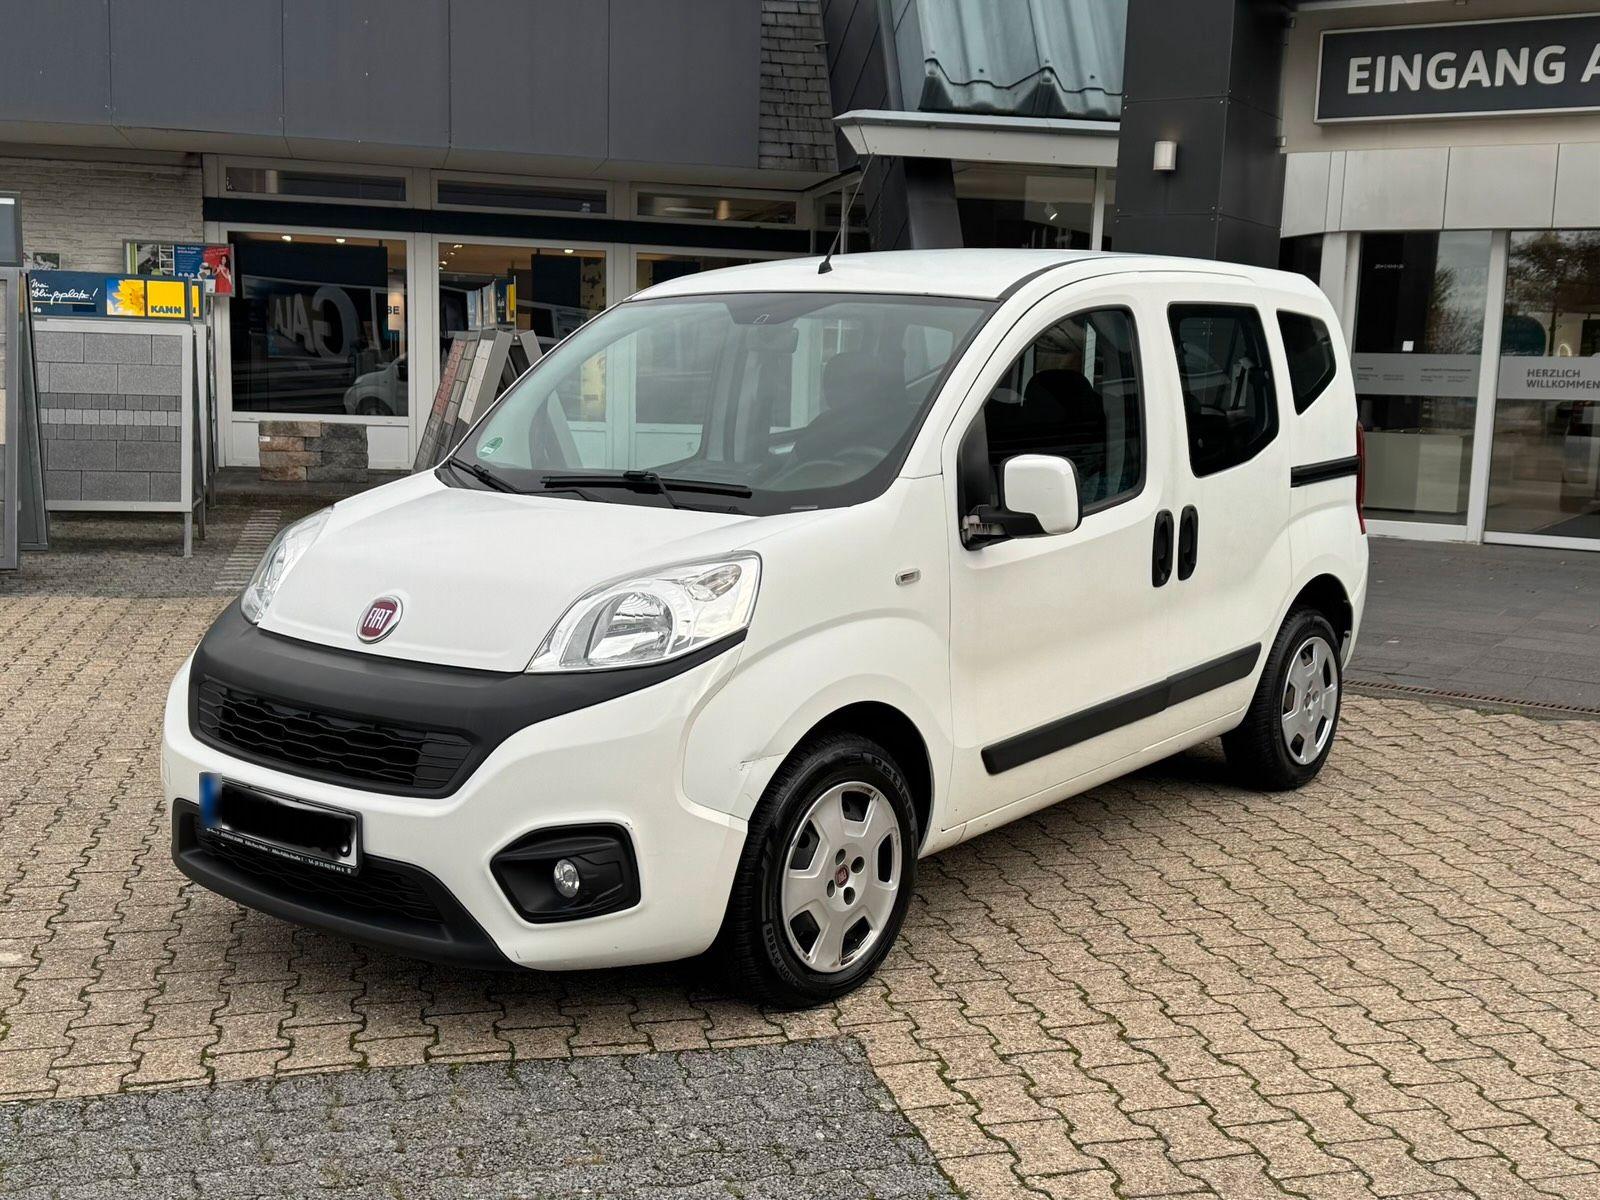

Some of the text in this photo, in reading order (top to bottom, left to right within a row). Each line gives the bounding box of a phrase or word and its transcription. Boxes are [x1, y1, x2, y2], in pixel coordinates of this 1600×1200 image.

[1347, 45, 1566, 94] EINGANG
[151, 305, 182, 314] KANN
[1527, 368, 1581, 378] HERZLICH
[1526, 379, 1600, 389] WILLKOMMEN
[364, 607, 393, 630] FIAT
